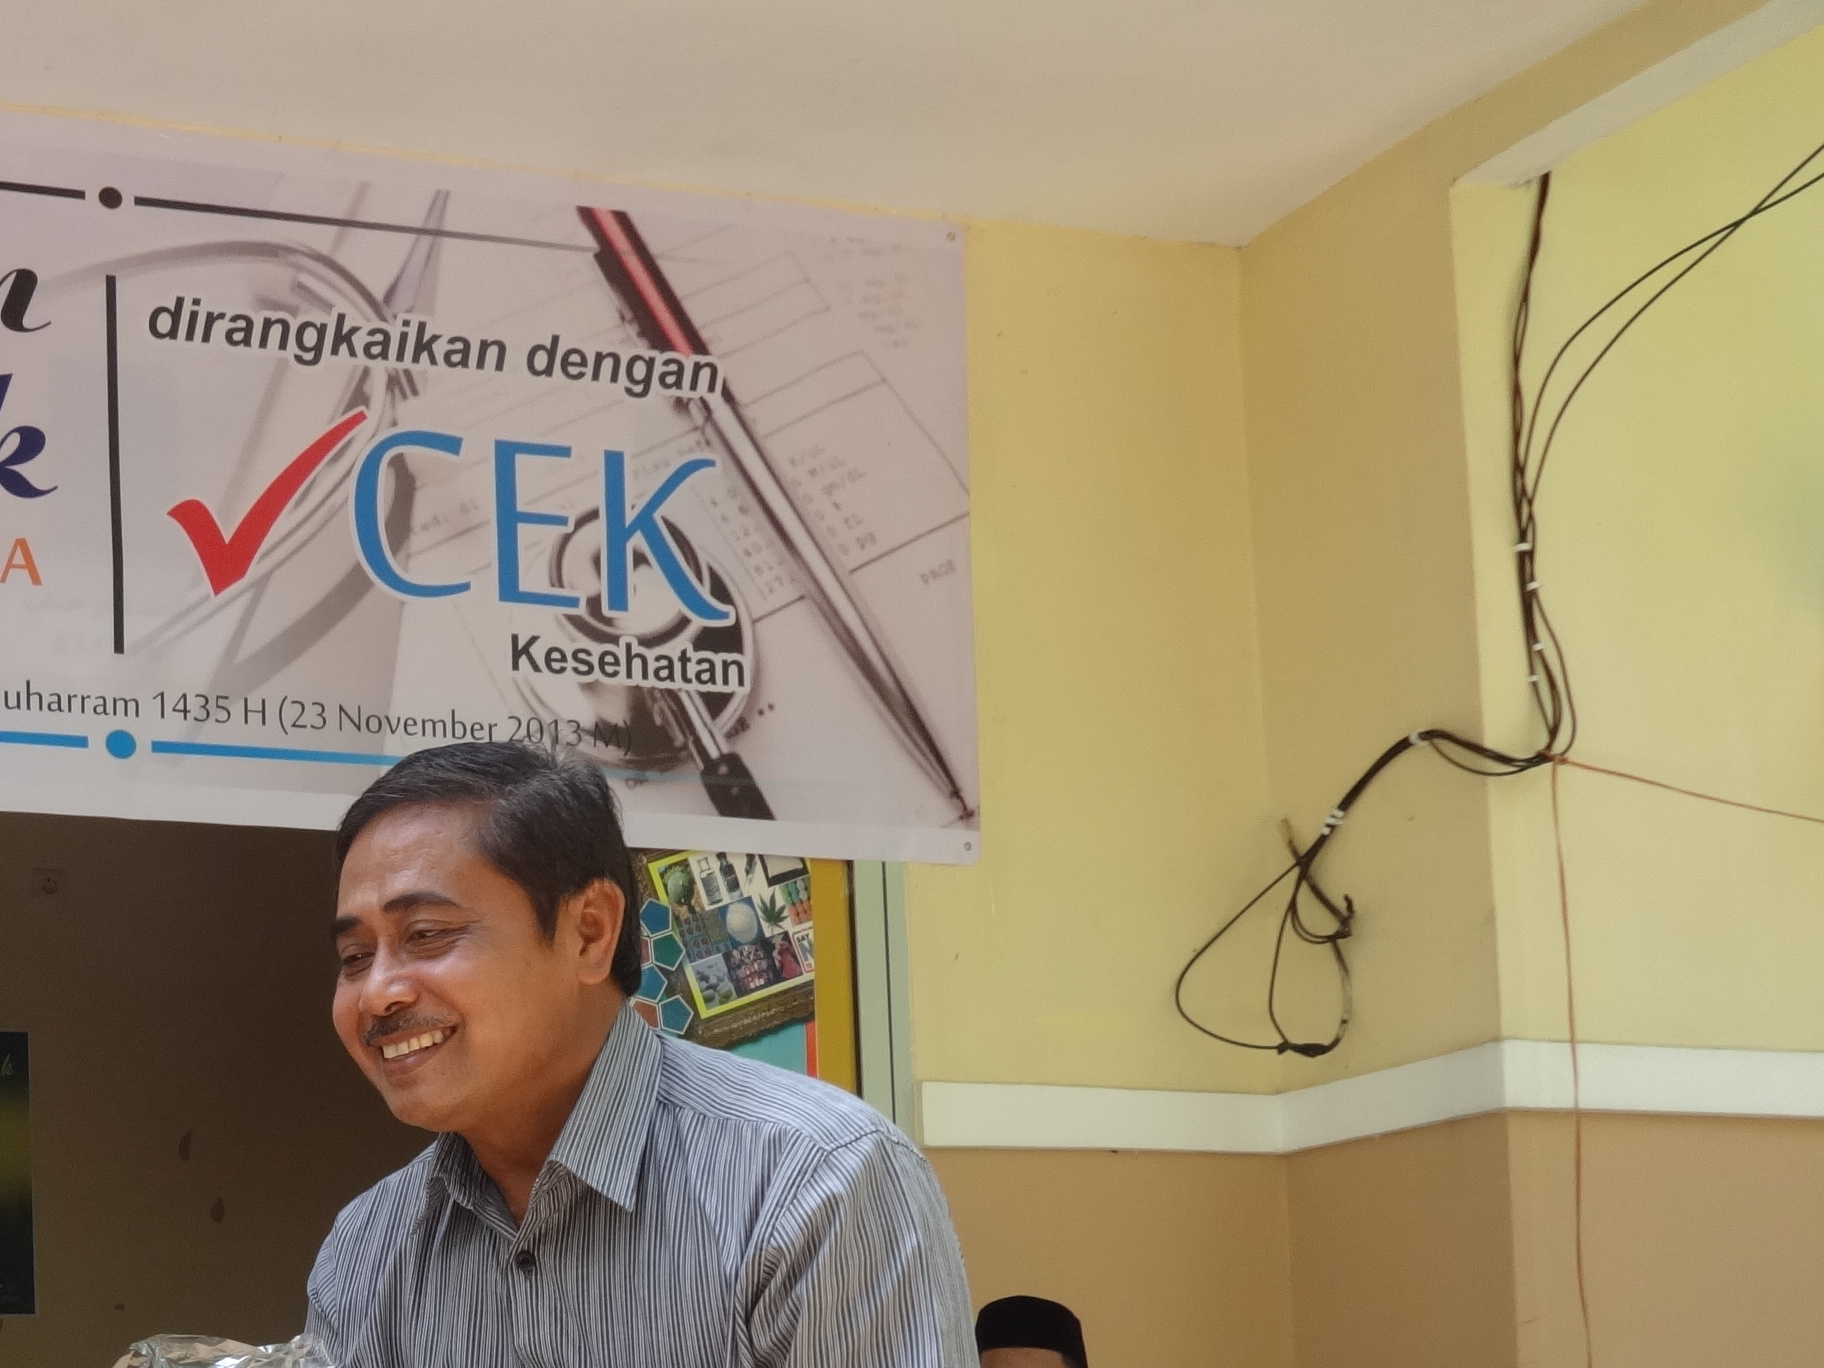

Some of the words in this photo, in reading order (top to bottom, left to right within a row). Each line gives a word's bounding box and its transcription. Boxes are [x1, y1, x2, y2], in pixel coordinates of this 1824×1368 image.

[147, 297, 507, 372] dirangkaikan
[525, 333, 722, 399] dengan
[352, 428, 732, 624] CEK
[509, 634, 747, 689] Kesehatan
[153, 692, 233, 725] 1435
[244, 697, 268, 727] H
[278, 696, 327, 735] (23
[337, 703, 499, 742] November
[508, 715, 583, 748] 2013
